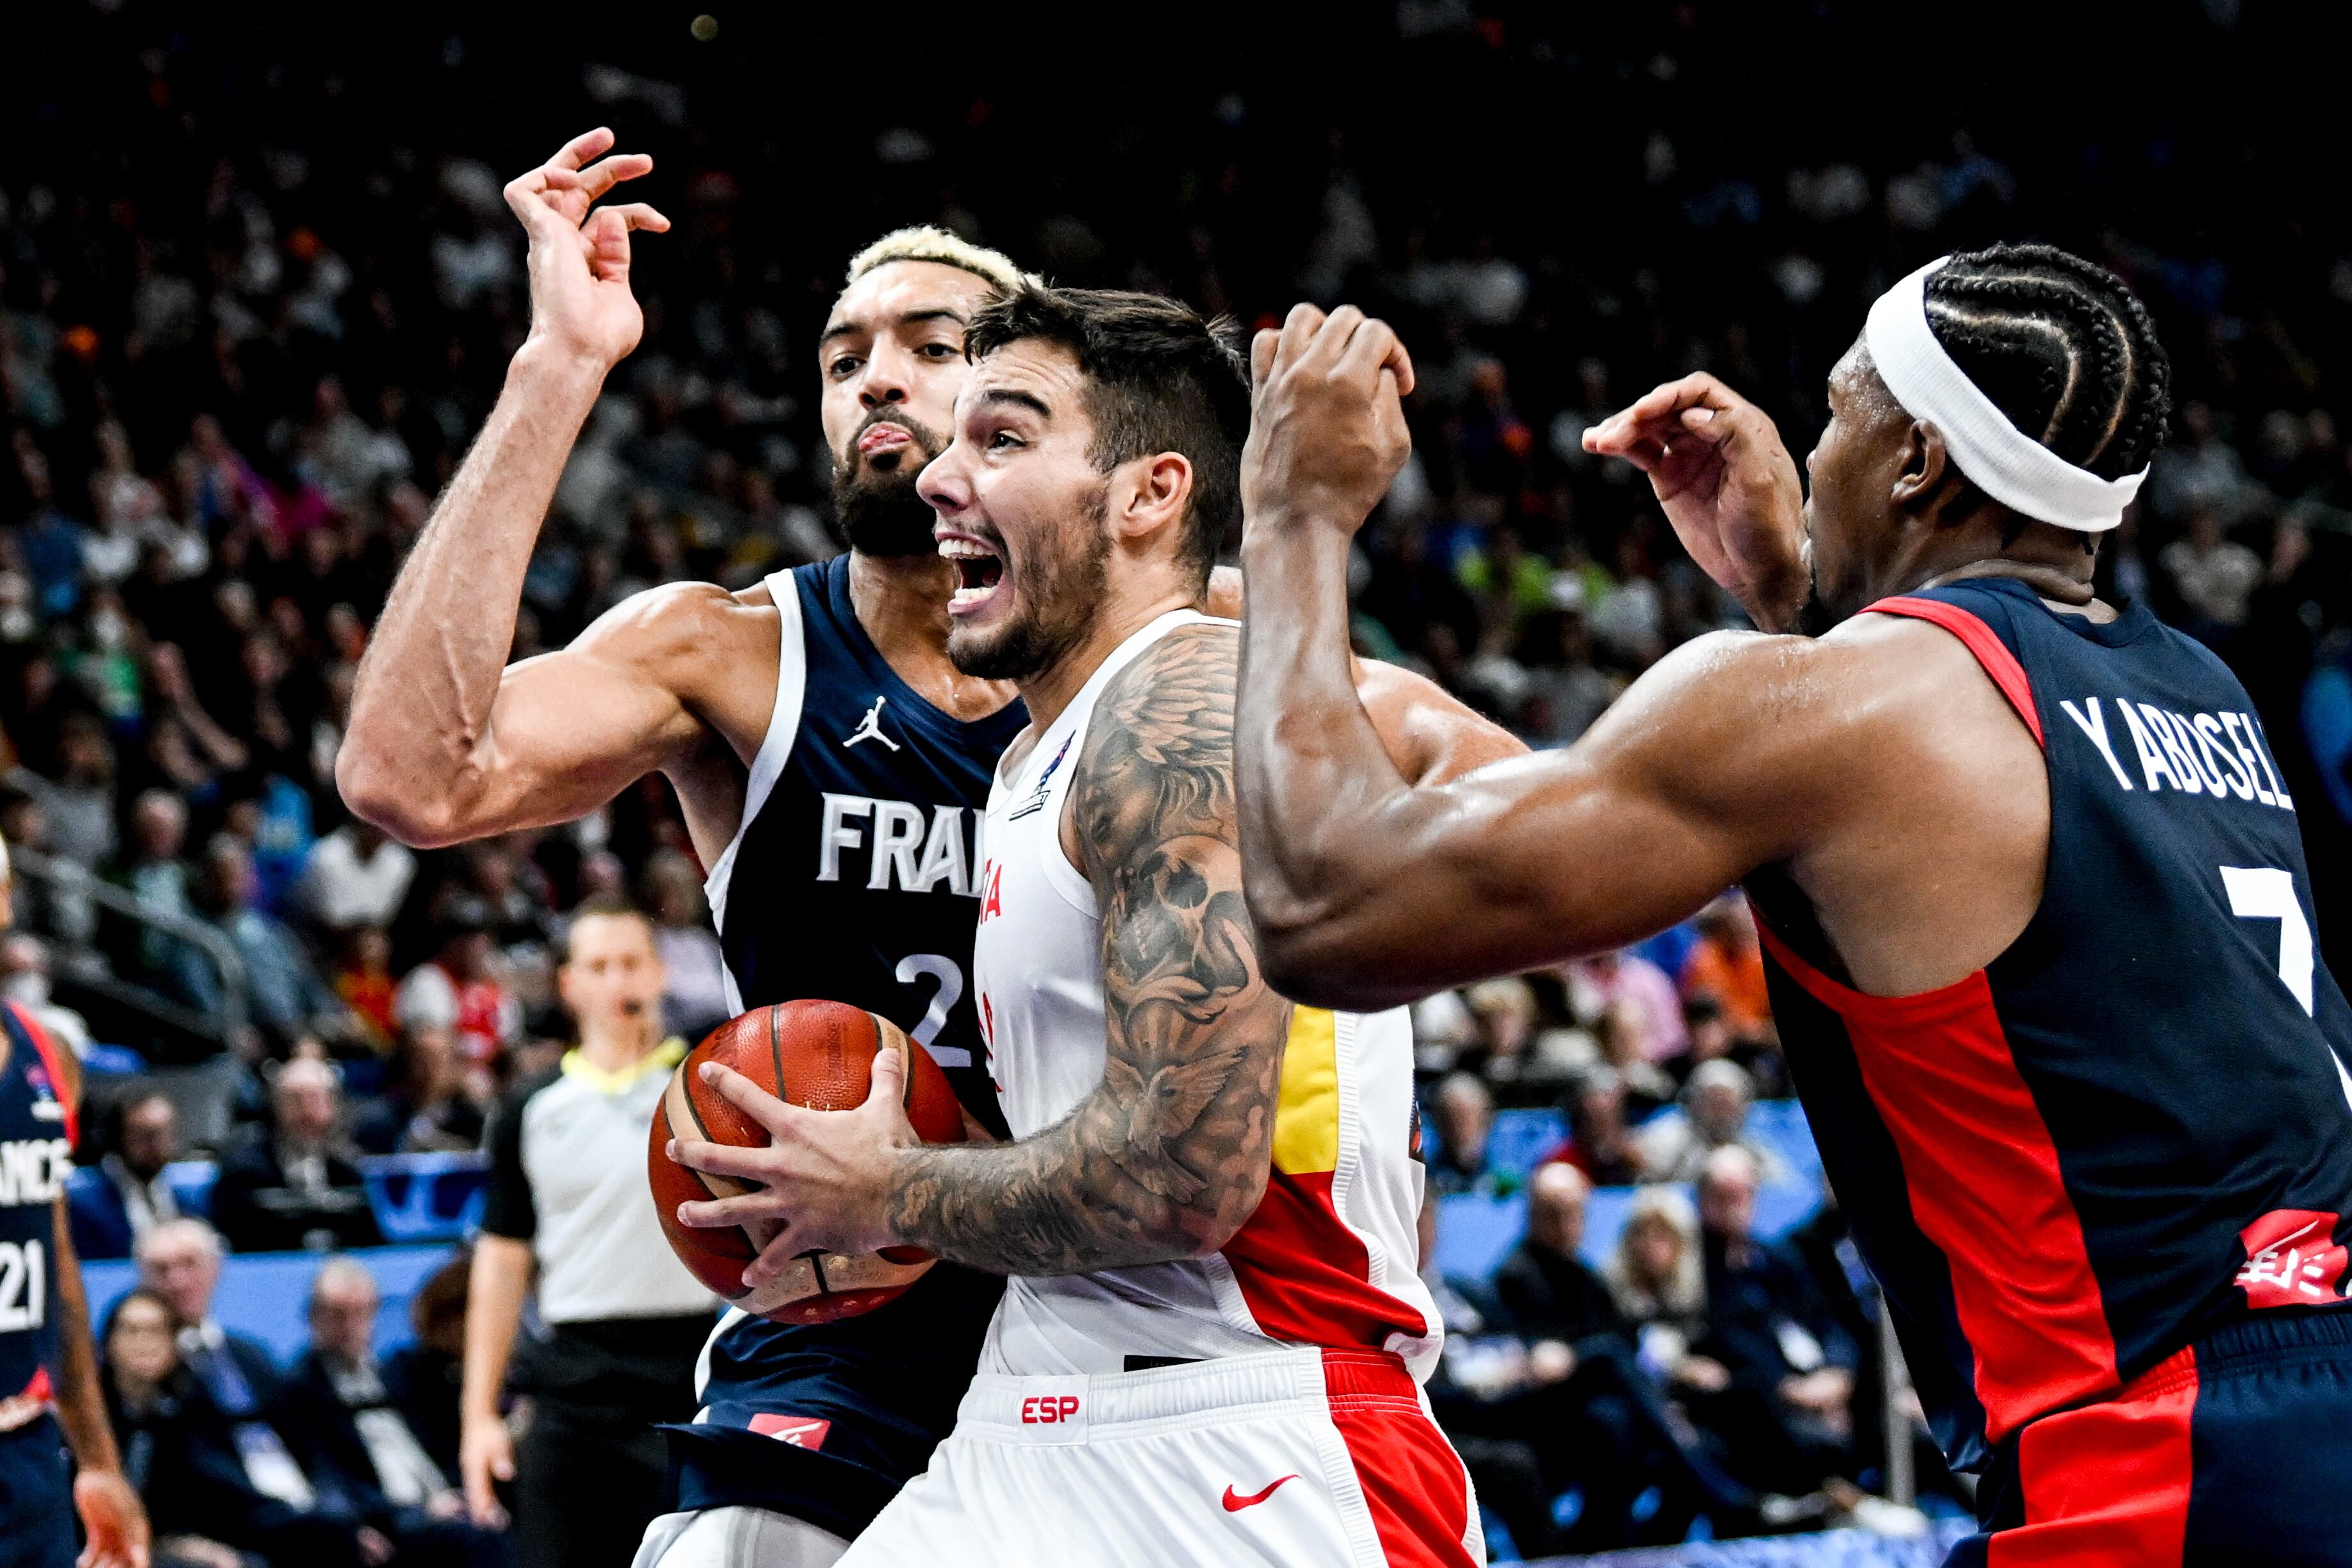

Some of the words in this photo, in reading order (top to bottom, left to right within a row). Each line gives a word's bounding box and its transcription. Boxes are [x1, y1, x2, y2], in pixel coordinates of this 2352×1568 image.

[2059, 696, 2295, 811] YABUSEL
[896, 954, 972, 1067] 2
[0, 1239, 46, 1333] 21
[1022, 1396, 1080, 1424] ESP
